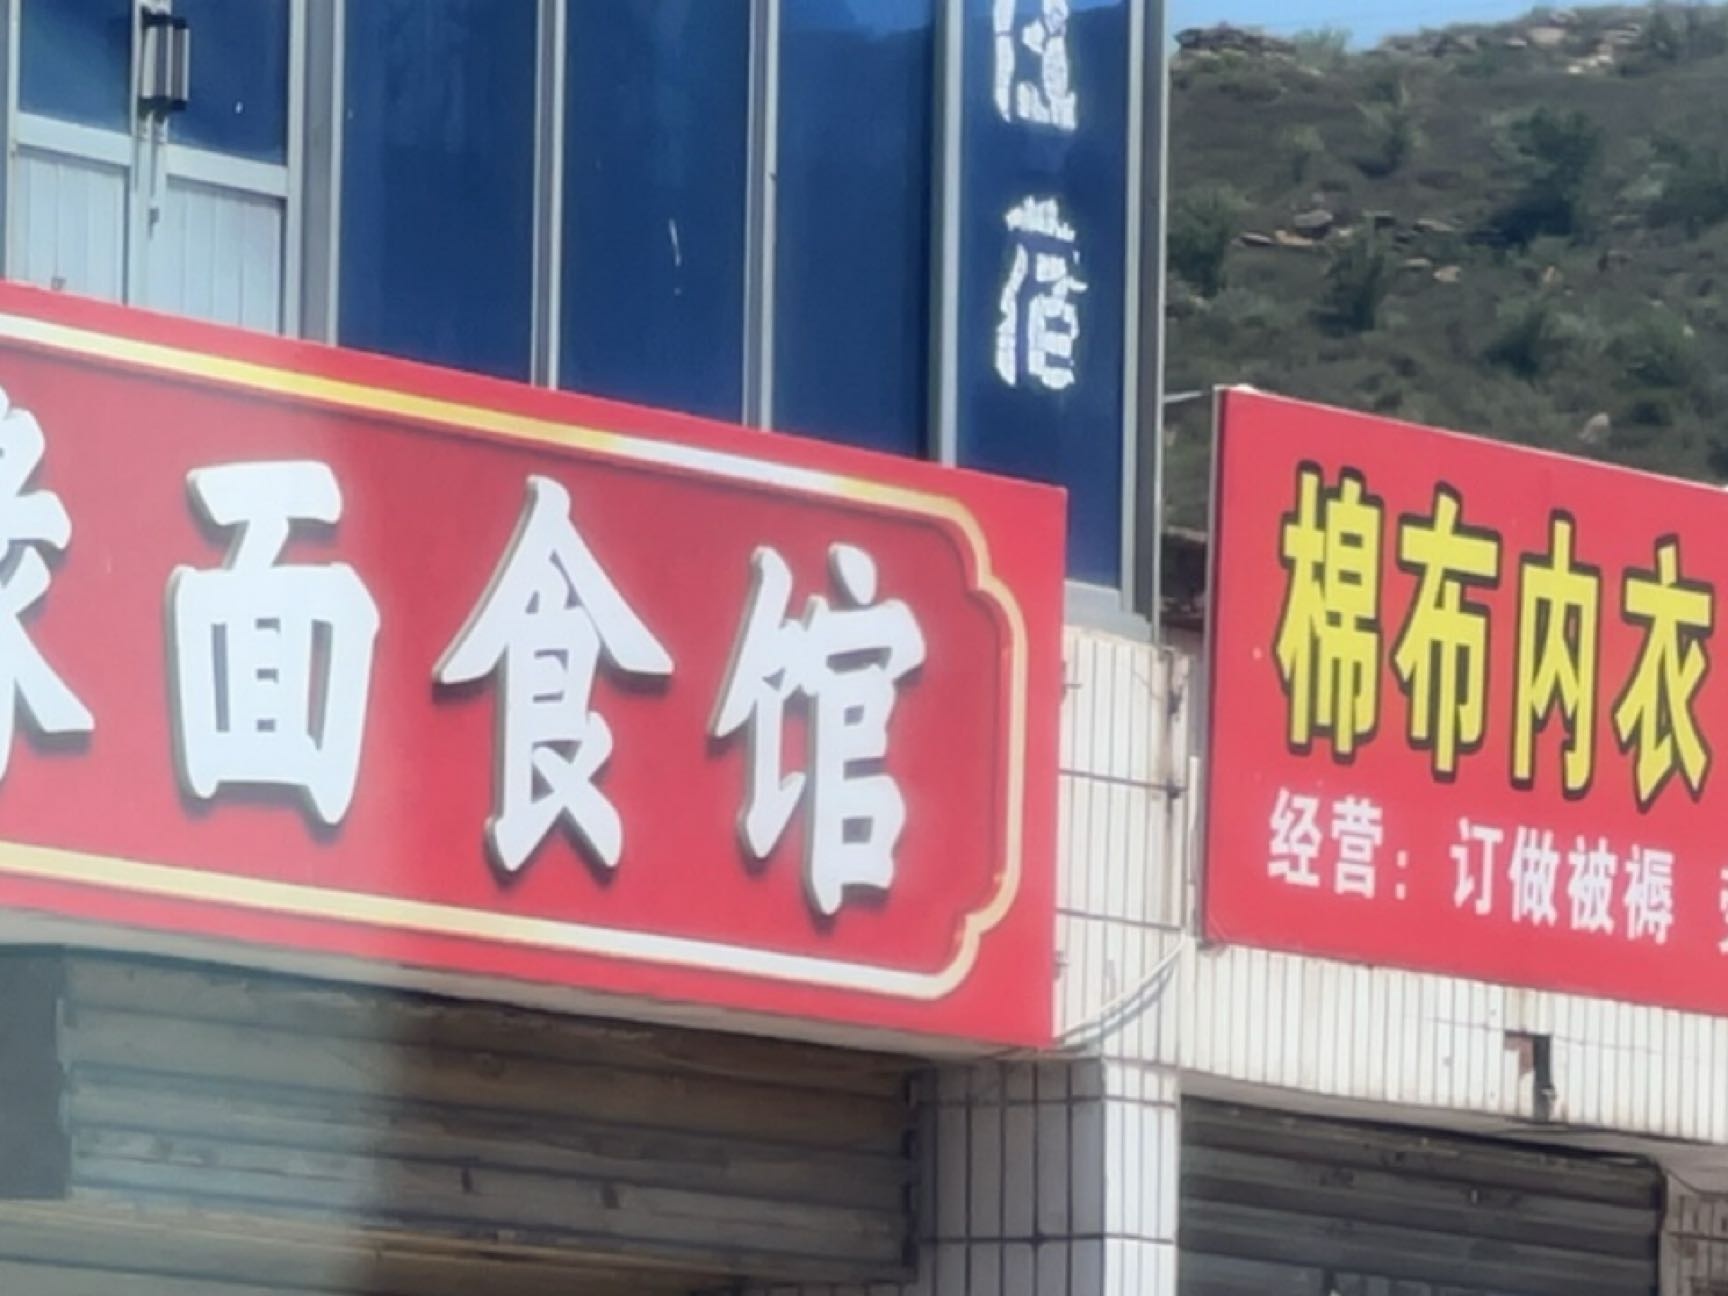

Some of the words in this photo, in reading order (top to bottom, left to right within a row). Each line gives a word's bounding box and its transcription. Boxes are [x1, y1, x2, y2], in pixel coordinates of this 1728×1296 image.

[1275, 461, 1715, 809] 棉布内衣
[1449, 817, 1675, 945] 订做被褥
